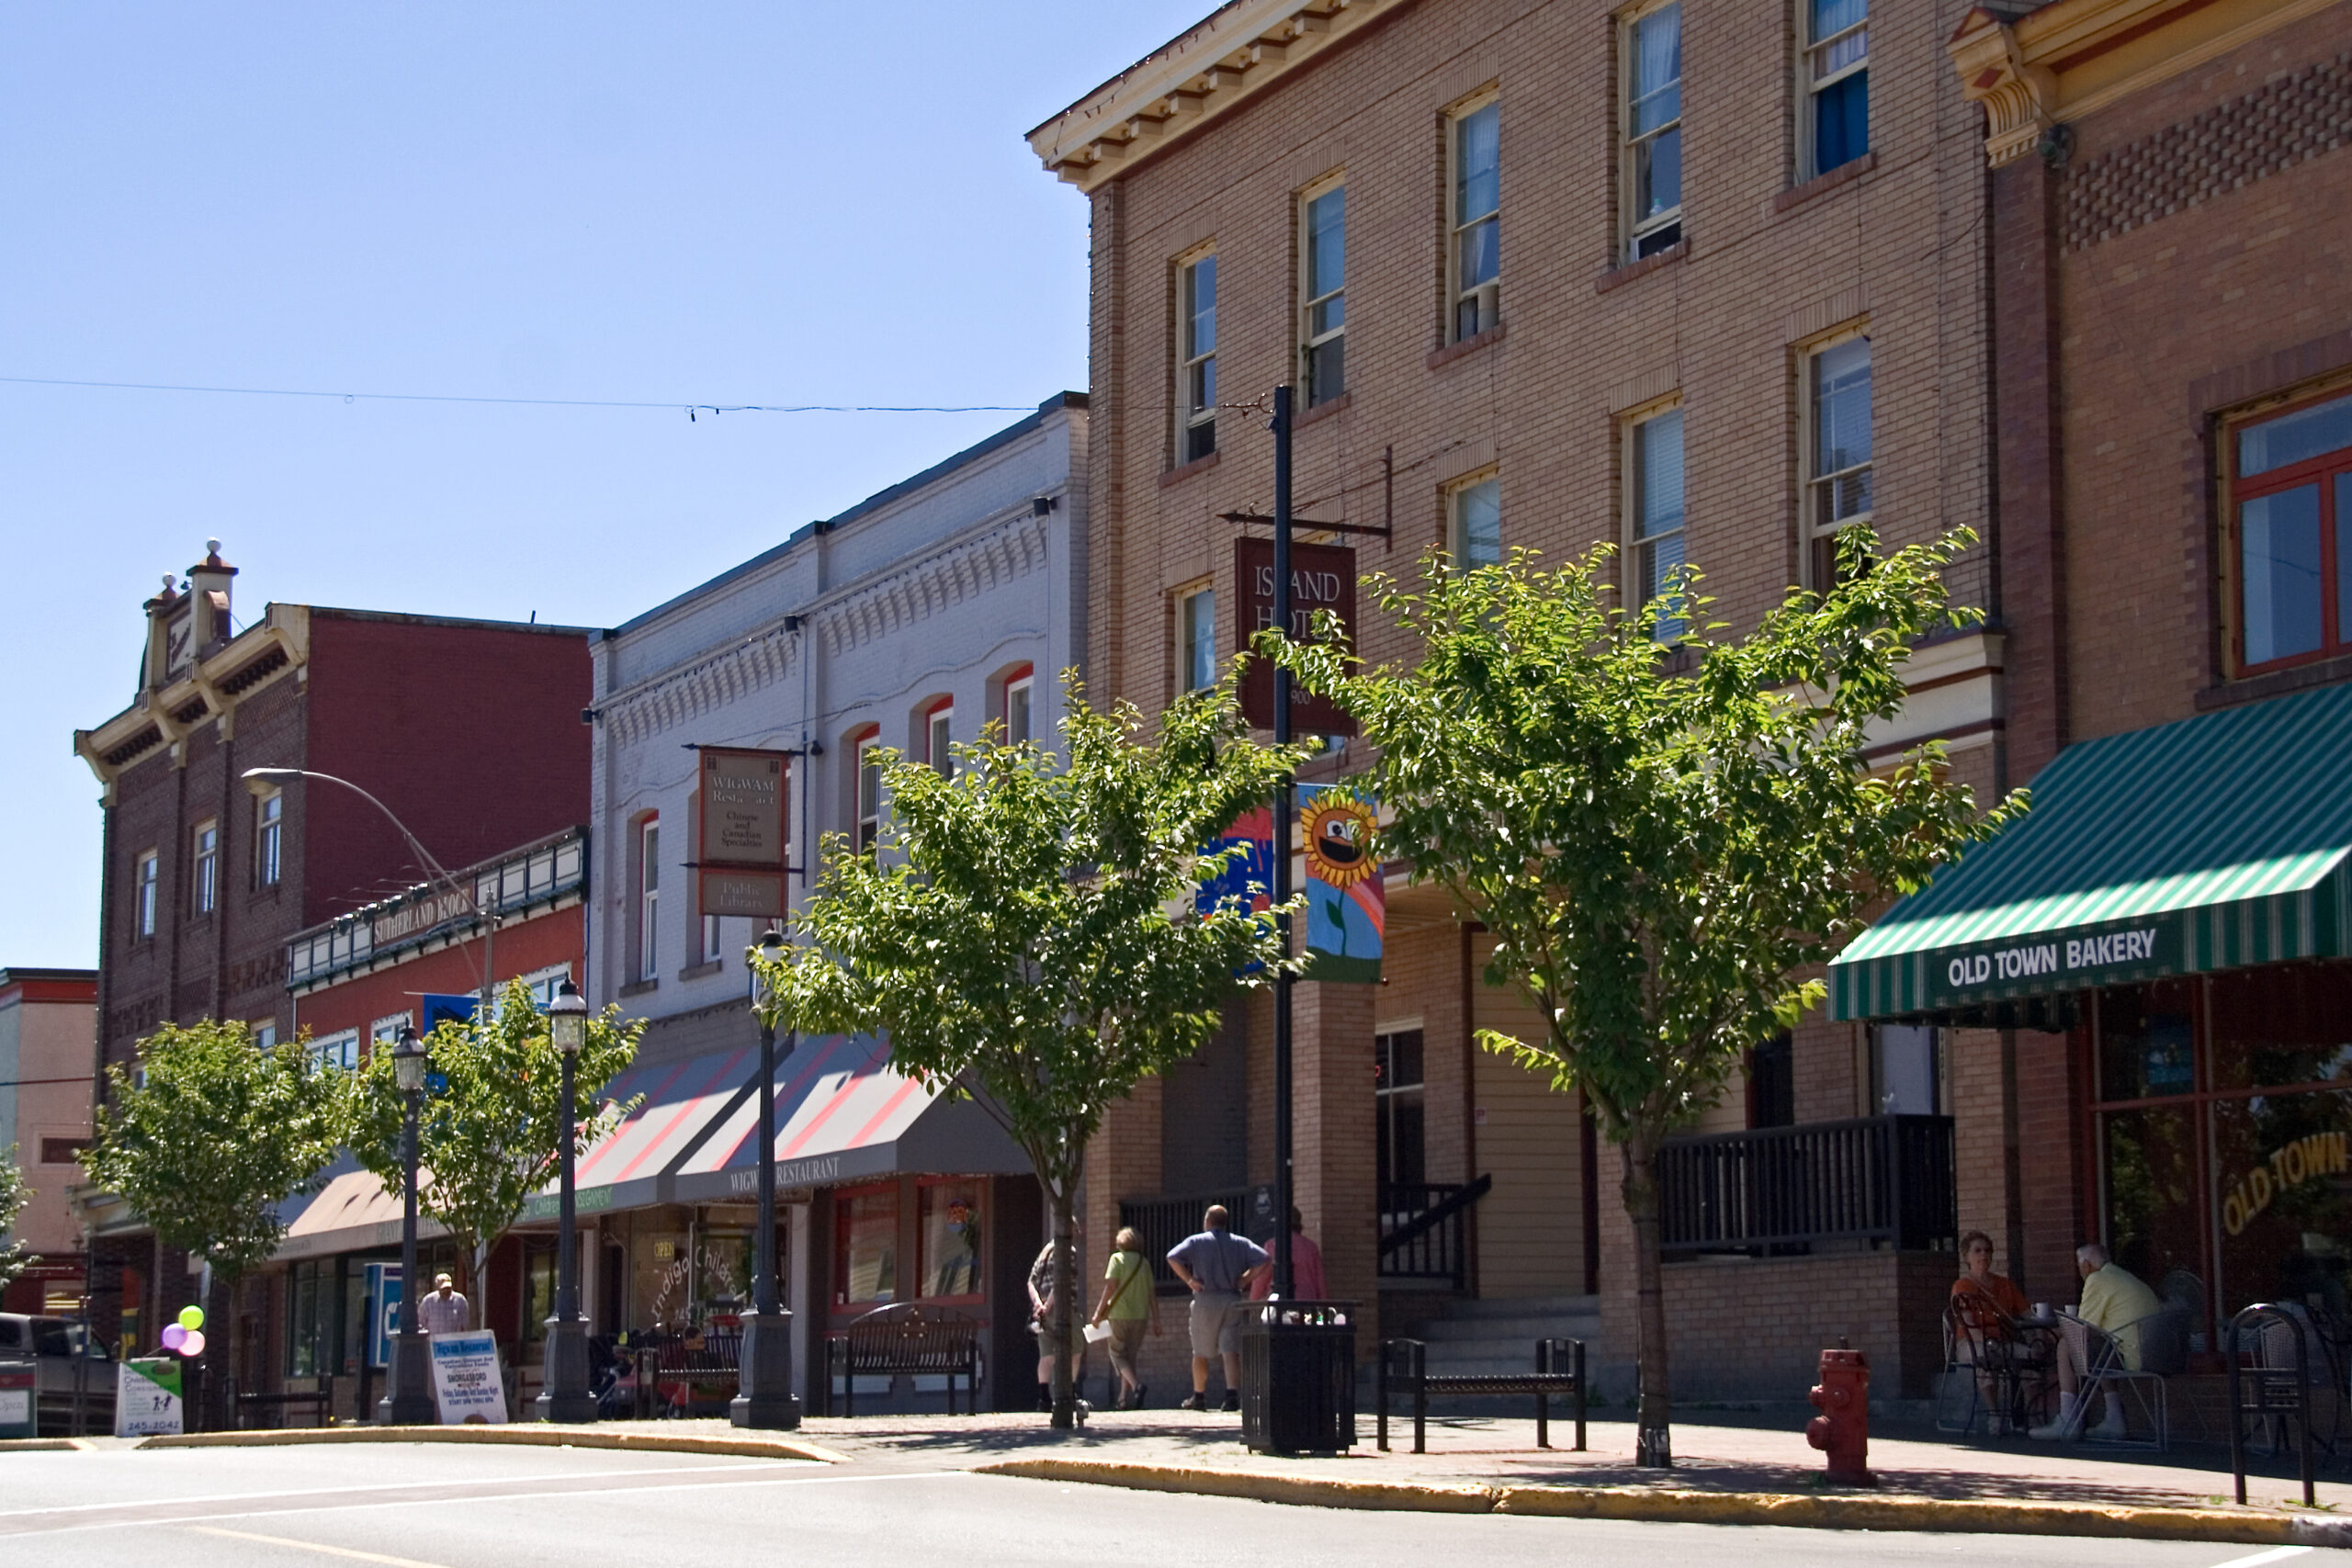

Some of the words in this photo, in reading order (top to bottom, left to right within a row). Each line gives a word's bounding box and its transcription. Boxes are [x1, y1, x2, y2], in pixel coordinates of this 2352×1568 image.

[1255, 566, 1340, 602] ISAND
[1290, 690, 1311, 705] 900
[713, 776, 775, 793] WIGWAM
[374, 901, 435, 945] SUTHERLAND
[436, 887, 470, 923] BLOCK
[1948, 954, 1991, 987] OLD
[1995, 943, 2058, 980] TOWN
[2066, 928, 2156, 969] BAKERY
[775, 1156, 841, 1186] RESTAURANT
[2223, 1166, 2272, 1236] OLD
[2269, 1130, 2347, 1193] TOWN
[654, 1241, 674, 1258] OPEN
[651, 1256, 690, 1322] Indigo
